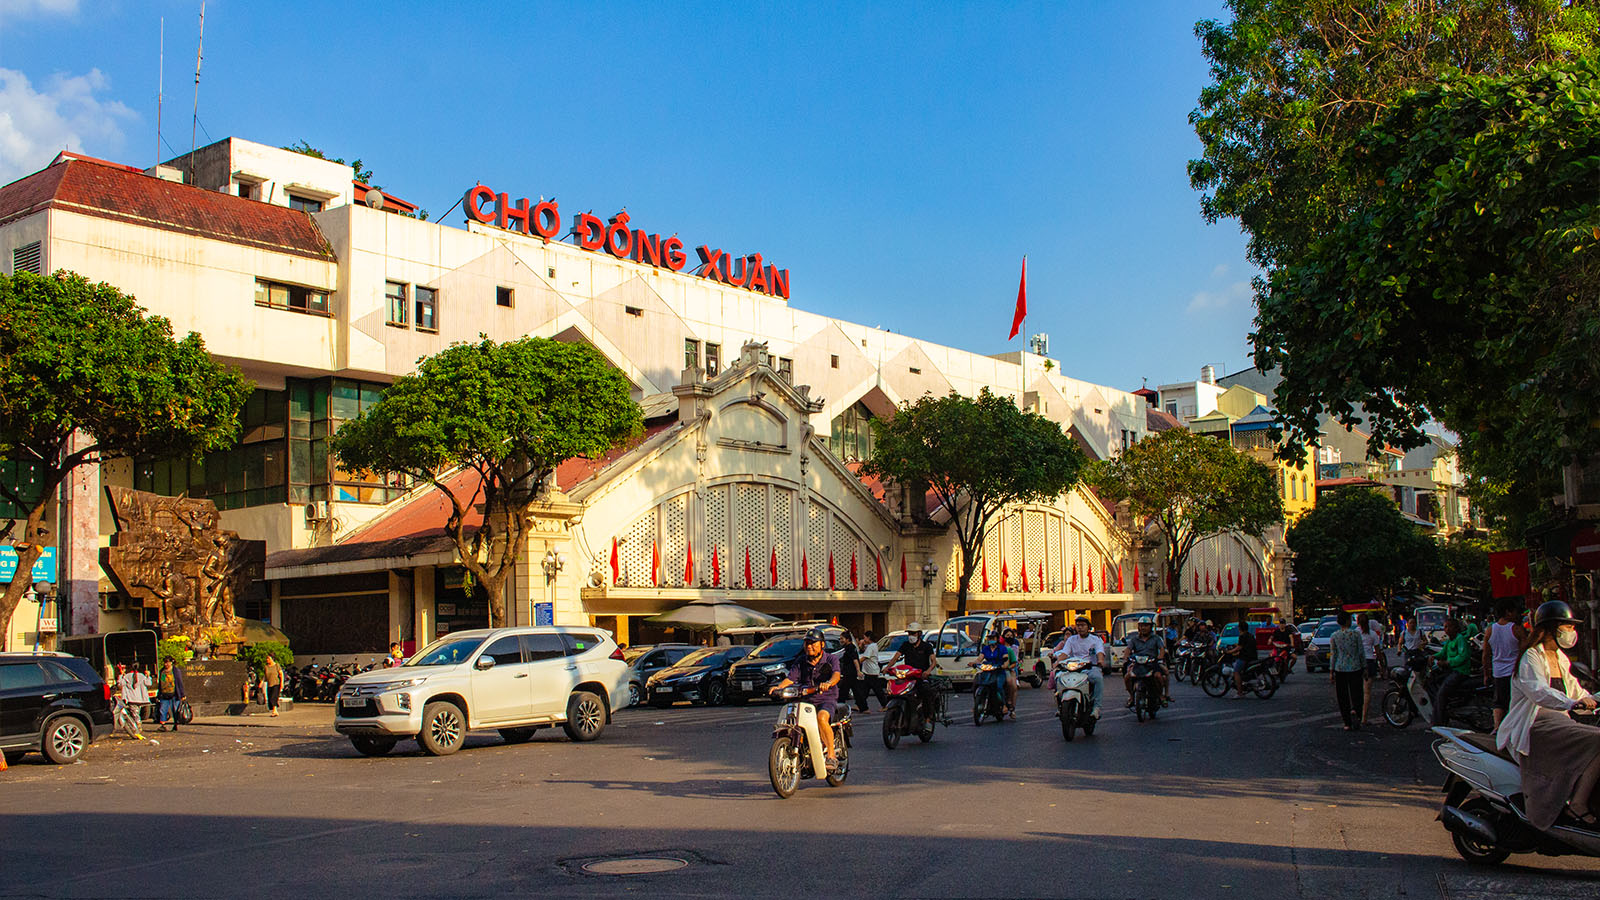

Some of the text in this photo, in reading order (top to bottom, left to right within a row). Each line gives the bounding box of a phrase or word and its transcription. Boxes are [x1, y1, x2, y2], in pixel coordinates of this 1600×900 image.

[463, 185, 790, 299] CHỢ ĐỒNG XUÂN
